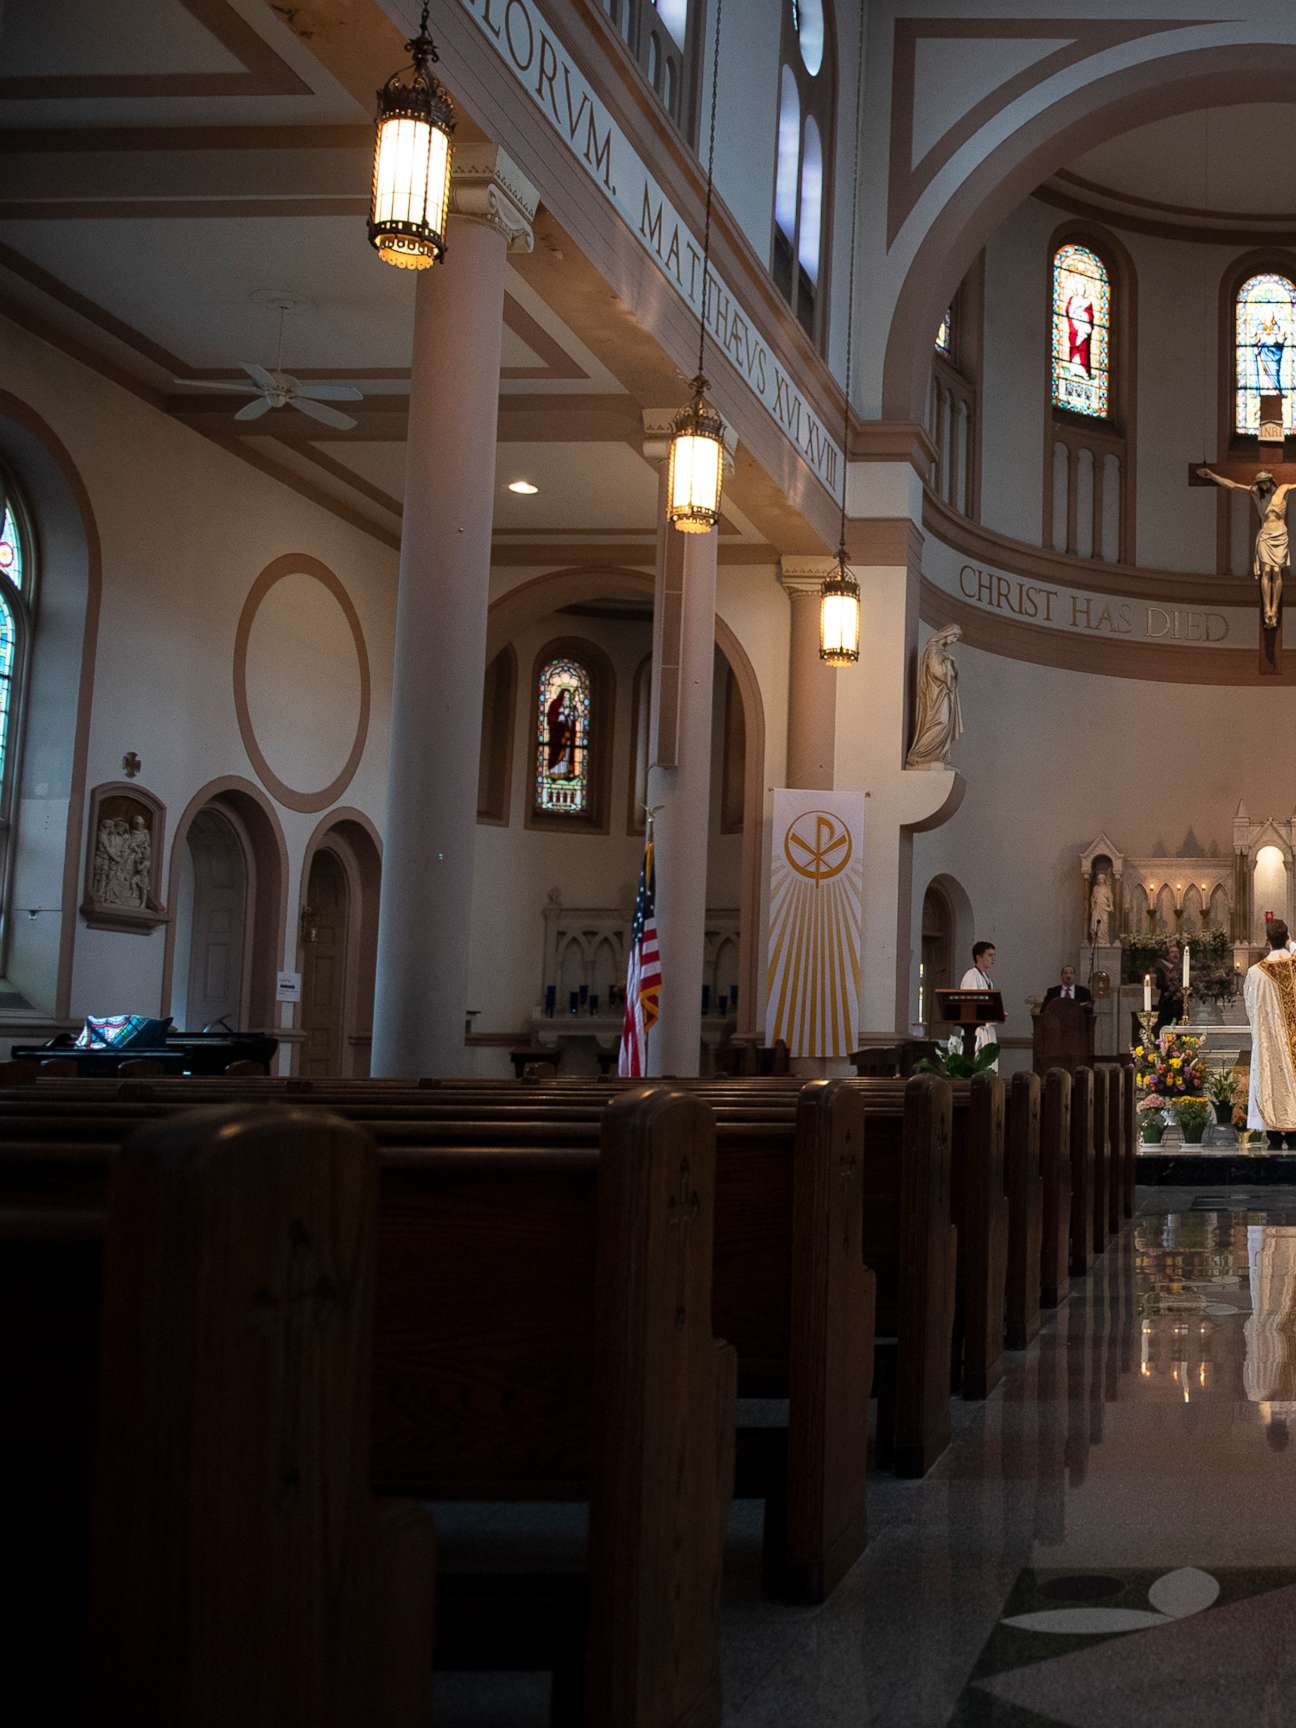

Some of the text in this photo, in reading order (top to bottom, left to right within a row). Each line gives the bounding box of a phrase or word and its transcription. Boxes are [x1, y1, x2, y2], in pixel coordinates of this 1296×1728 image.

[468, 0, 619, 196] LORVM.
[772, 367, 801, 443] XVI
[805, 412, 837, 491] XVIII
[959, 565, 1229, 642] CHRIST HAS DIED
